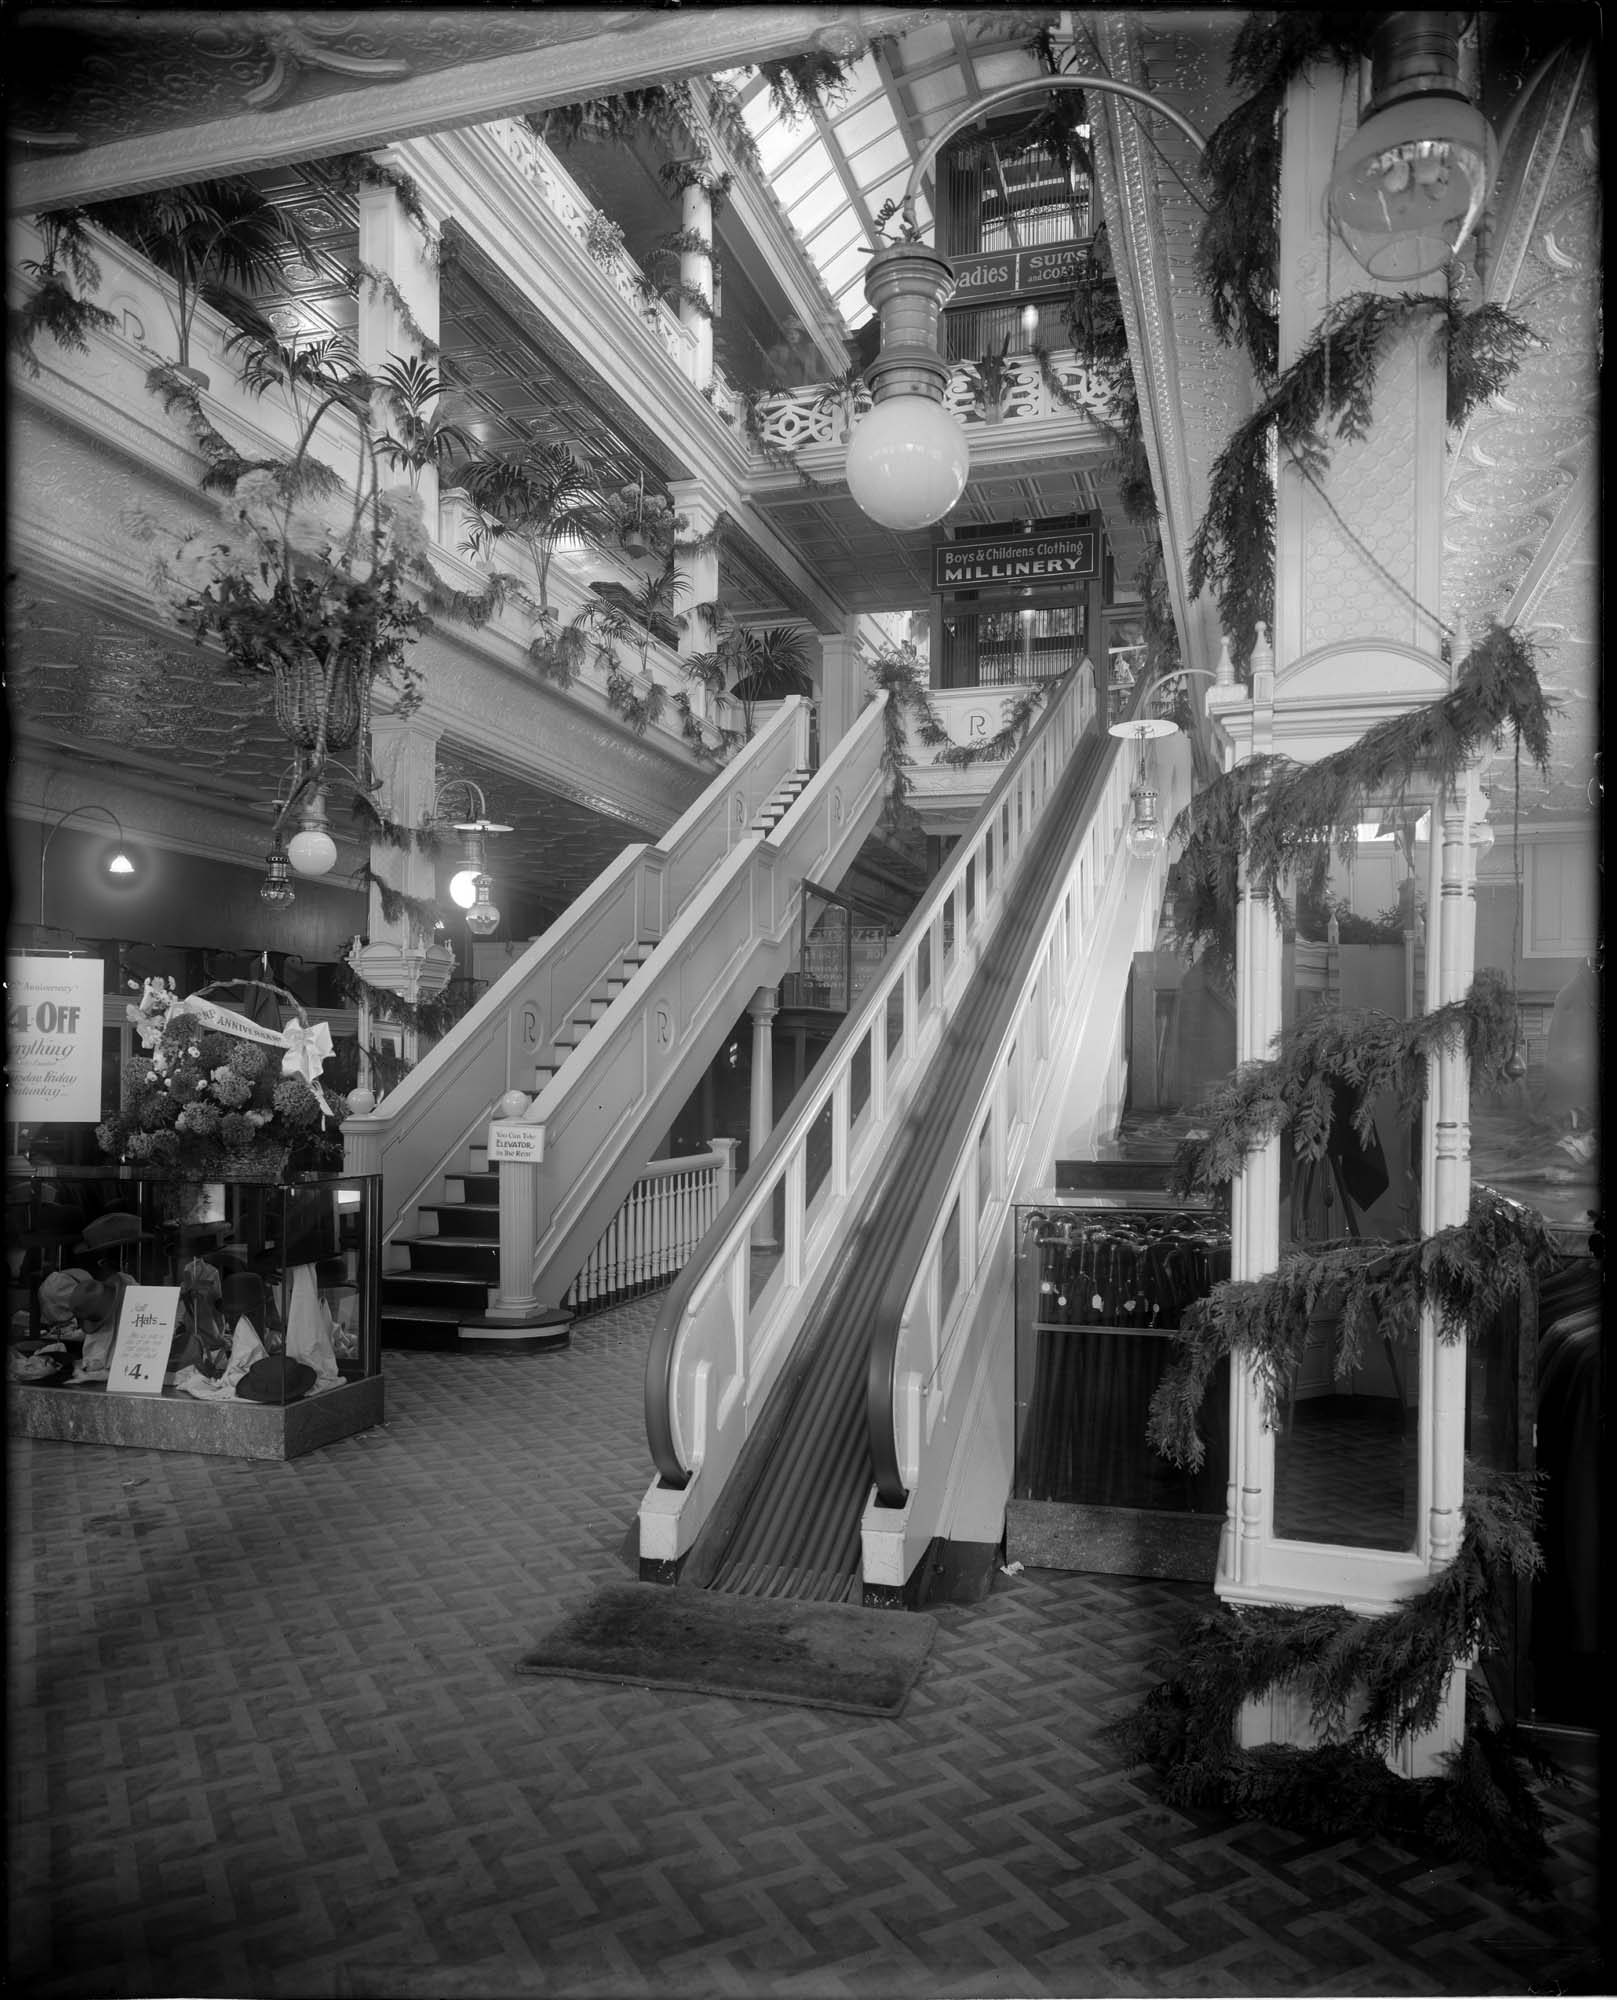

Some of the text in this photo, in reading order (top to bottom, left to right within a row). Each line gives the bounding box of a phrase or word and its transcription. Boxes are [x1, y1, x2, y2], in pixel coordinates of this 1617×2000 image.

[1030, 249, 1088, 269] SUITS
[954, 264, 1008, 288] adies
[1027, 273, 1042, 283] and
[945, 540, 1084, 566] Boys & Childrens Clothing
[945, 556, 1082, 582] MILLINERY
[970, 715, 986, 736] R
[524, 1011, 536, 1043] R
[657, 1011, 668, 1043] R
[496, 1139, 535, 1150] ELEVATOR
